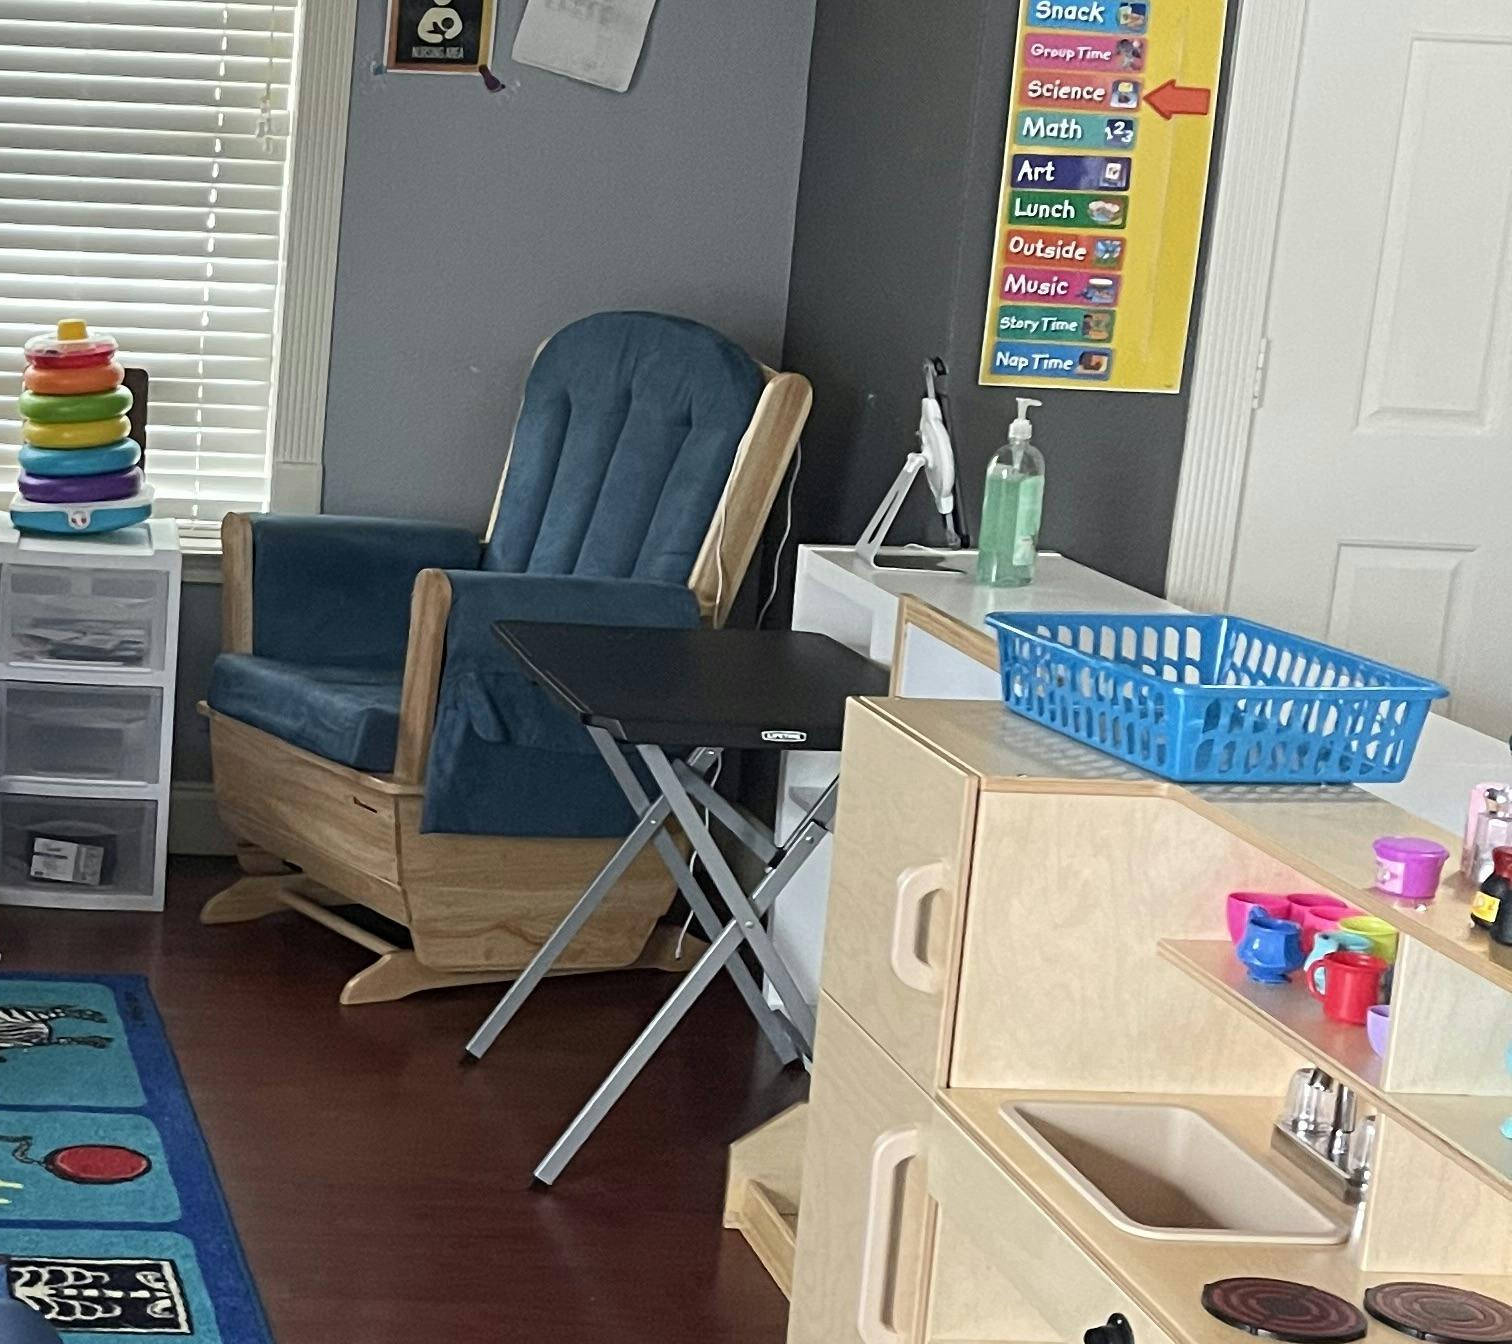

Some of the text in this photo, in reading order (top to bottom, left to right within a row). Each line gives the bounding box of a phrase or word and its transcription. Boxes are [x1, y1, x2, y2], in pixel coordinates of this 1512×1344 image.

[1035, 1, 1105, 24] Snack
[1030, 44, 1112, 61] Group Time
[1027, 81, 1106, 102] Science
[1023, 118, 1083, 140] Math
[1017, 161, 1056, 182] Art
[1014, 199, 1076, 219] Lunch
[1009, 237, 1087, 261] Outside
[1004, 275, 1069, 296] Music
[999, 316, 1078, 334] Story Time
[995, 353, 1074, 371] Nap Time
